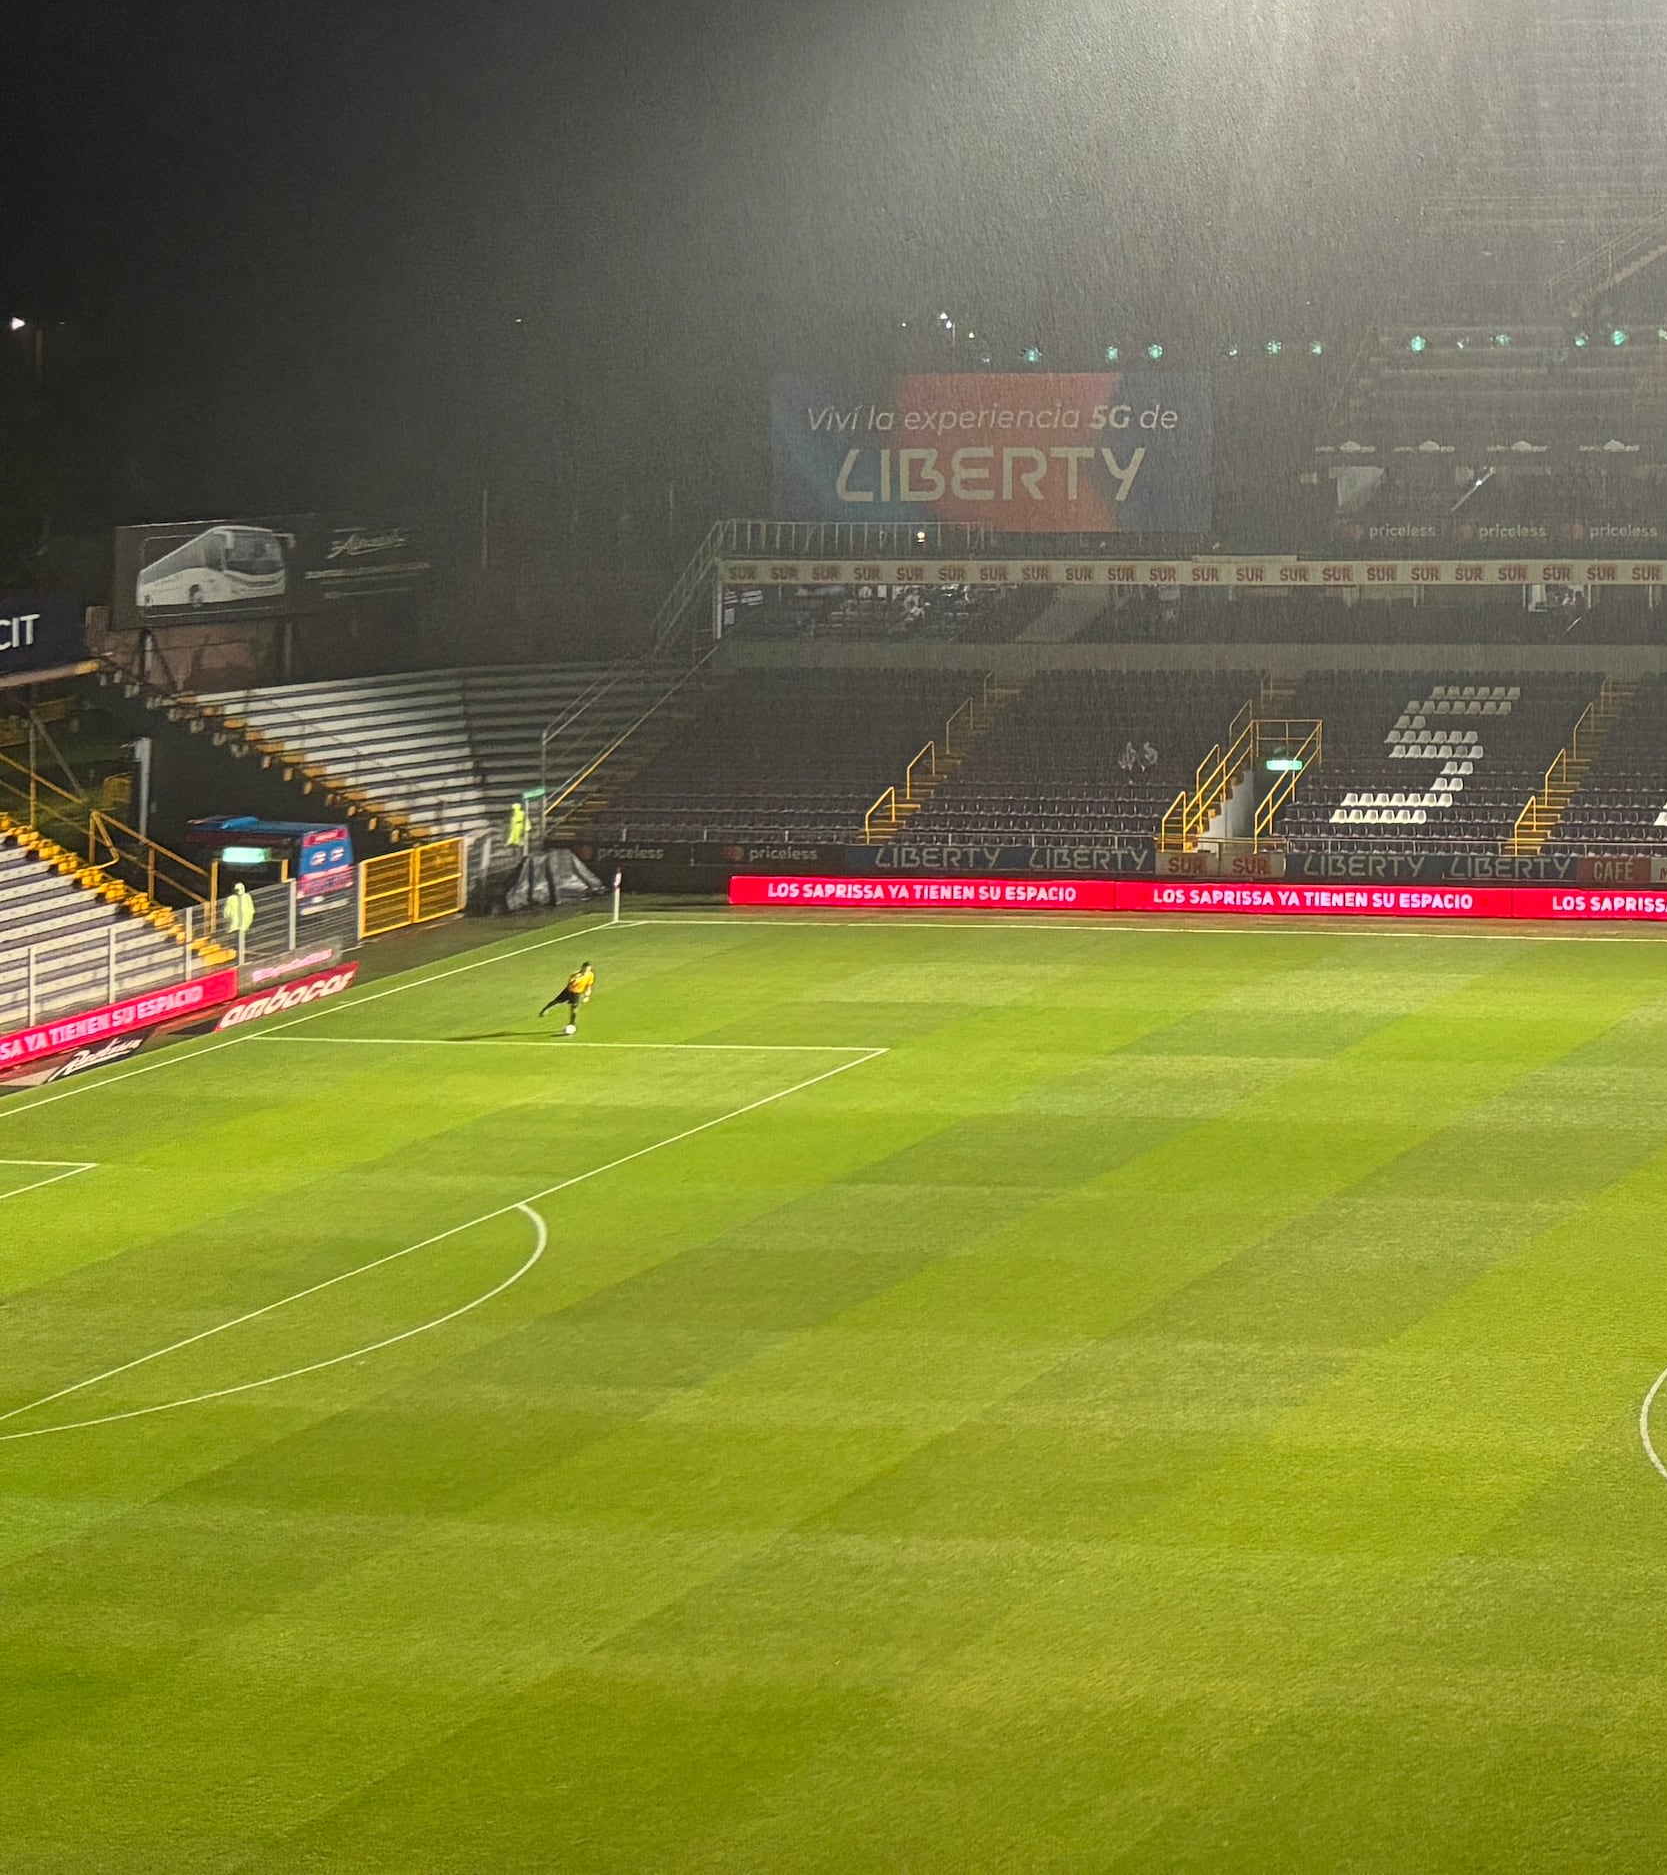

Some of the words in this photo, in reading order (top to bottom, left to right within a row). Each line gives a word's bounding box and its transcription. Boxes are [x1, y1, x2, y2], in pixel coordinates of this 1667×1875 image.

[806, 405, 863, 431] Viví
[868, 404, 895, 431] la
[904, 403, 1080, 435] experiencia
[1088, 404, 1131, 429] 5G
[1140, 404, 1179, 429] de
[835, 446, 1146, 503] LIBERTY
[1368, 521, 1436, 539] priceless
[1589, 523, 1658, 540] priceless
[896, 566, 924, 582] SUR
[1107, 565, 1136, 582] SUR
[1322, 566, 1352, 582] SUR
[1498, 564, 1528, 581] SUR
[749, 845, 819, 862] priceless
[874, 846, 1003, 869] LIBERTY
[1028, 848, 1149, 871] LIBERTY
[1167, 855, 1205, 874] SUR
[1231, 857, 1270, 876] SUR
[1303, 855, 1426, 878] LIBERTY
[1450, 857, 1571, 879] LIBERTY
[1593, 856, 1634, 881] CAFÉ
[768, 883, 800, 898] LOS
[803, 883, 884, 899] SAPRISSA
[889, 885, 909, 898] YA
[913, 885, 975, 900] TIENEN
[979, 886, 1001, 901] SU
[1005, 886, 1076, 902] ESPACIO
[1153, 889, 1186, 904] LOS
[1190, 889, 1274, 906] SAPRISSA
[1277, 891, 1300, 906] YA
[1303, 891, 1368, 907] TIENEN
[1372, 892, 1395, 908] SU
[1399, 893, 1473, 910] ESPACIO
[1552, 896, 1586, 911] LOS
[24, 1030, 49, 1053] YA
